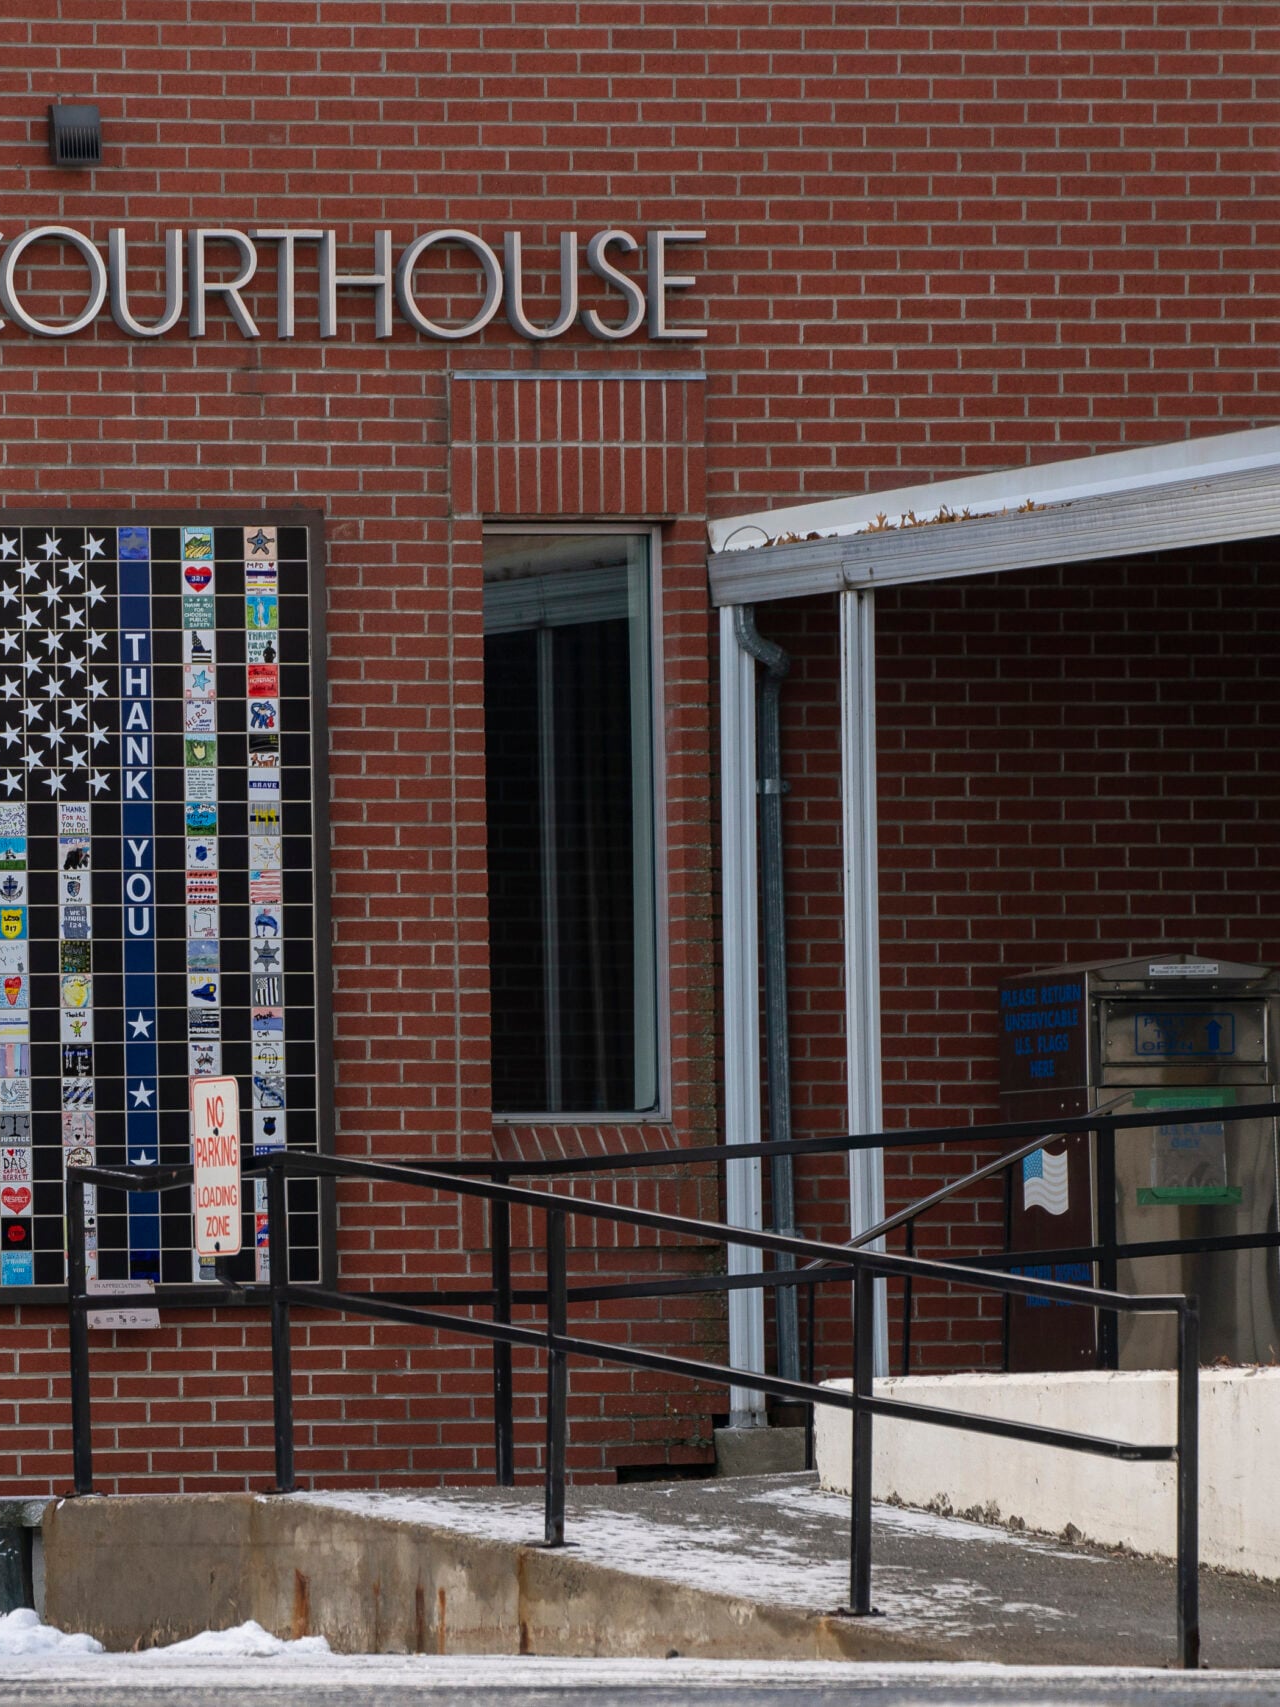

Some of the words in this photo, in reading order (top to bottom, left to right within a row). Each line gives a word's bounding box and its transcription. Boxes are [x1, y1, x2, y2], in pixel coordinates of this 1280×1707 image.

[124, 633, 149, 799] THANK
[186, 708, 207, 728] HERO
[59, 804, 87, 813] THANKS
[126, 839, 151, 936] YOU
[1001, 988, 1036, 1007] PLEASE
[1041, 984, 1082, 1004] RETURN
[1005, 1008, 1078, 1031] UNSERVICABLE
[1014, 1036, 1034, 1056] U.S.
[1037, 1032, 1069, 1053] FLAGS
[1142, 1041, 1193, 1051] OPEN
[1029, 1058, 1056, 1078] HERE
[206, 1095, 224, 1128] NO
[196, 1134, 238, 1168] PARKING
[3, 1157, 28, 1170] DAD
[198, 1185, 237, 1208] LOADING
[206, 1215, 231, 1238] ZONE
